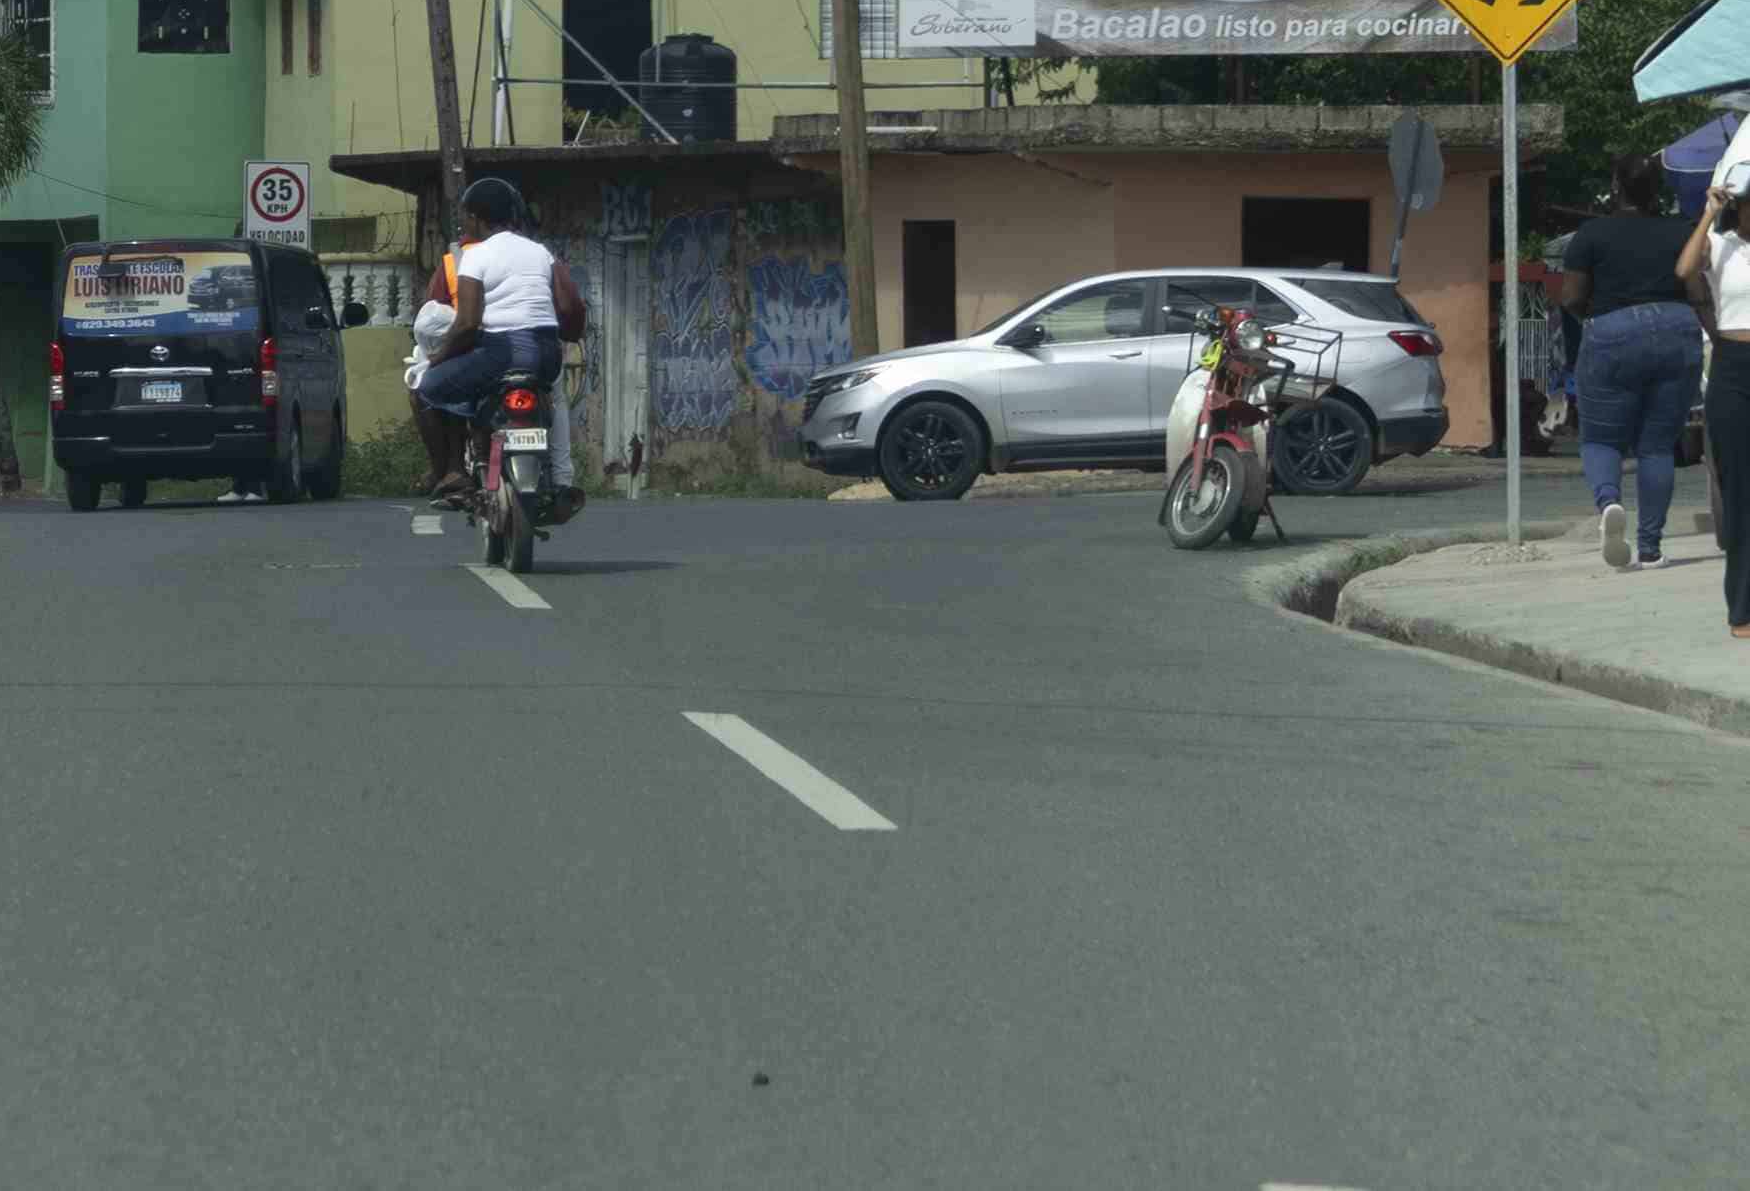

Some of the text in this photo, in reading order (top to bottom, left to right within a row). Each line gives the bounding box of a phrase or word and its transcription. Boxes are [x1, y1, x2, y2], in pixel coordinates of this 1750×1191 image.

[1052, 7, 1207, 40] Bacalao
[1215, 14, 1277, 37] listo
[1283, 16, 1348, 41] para
[262, 178, 292, 202] 35
[267, 204, 289, 214] KPH
[73, 278, 108, 298] LUIS
